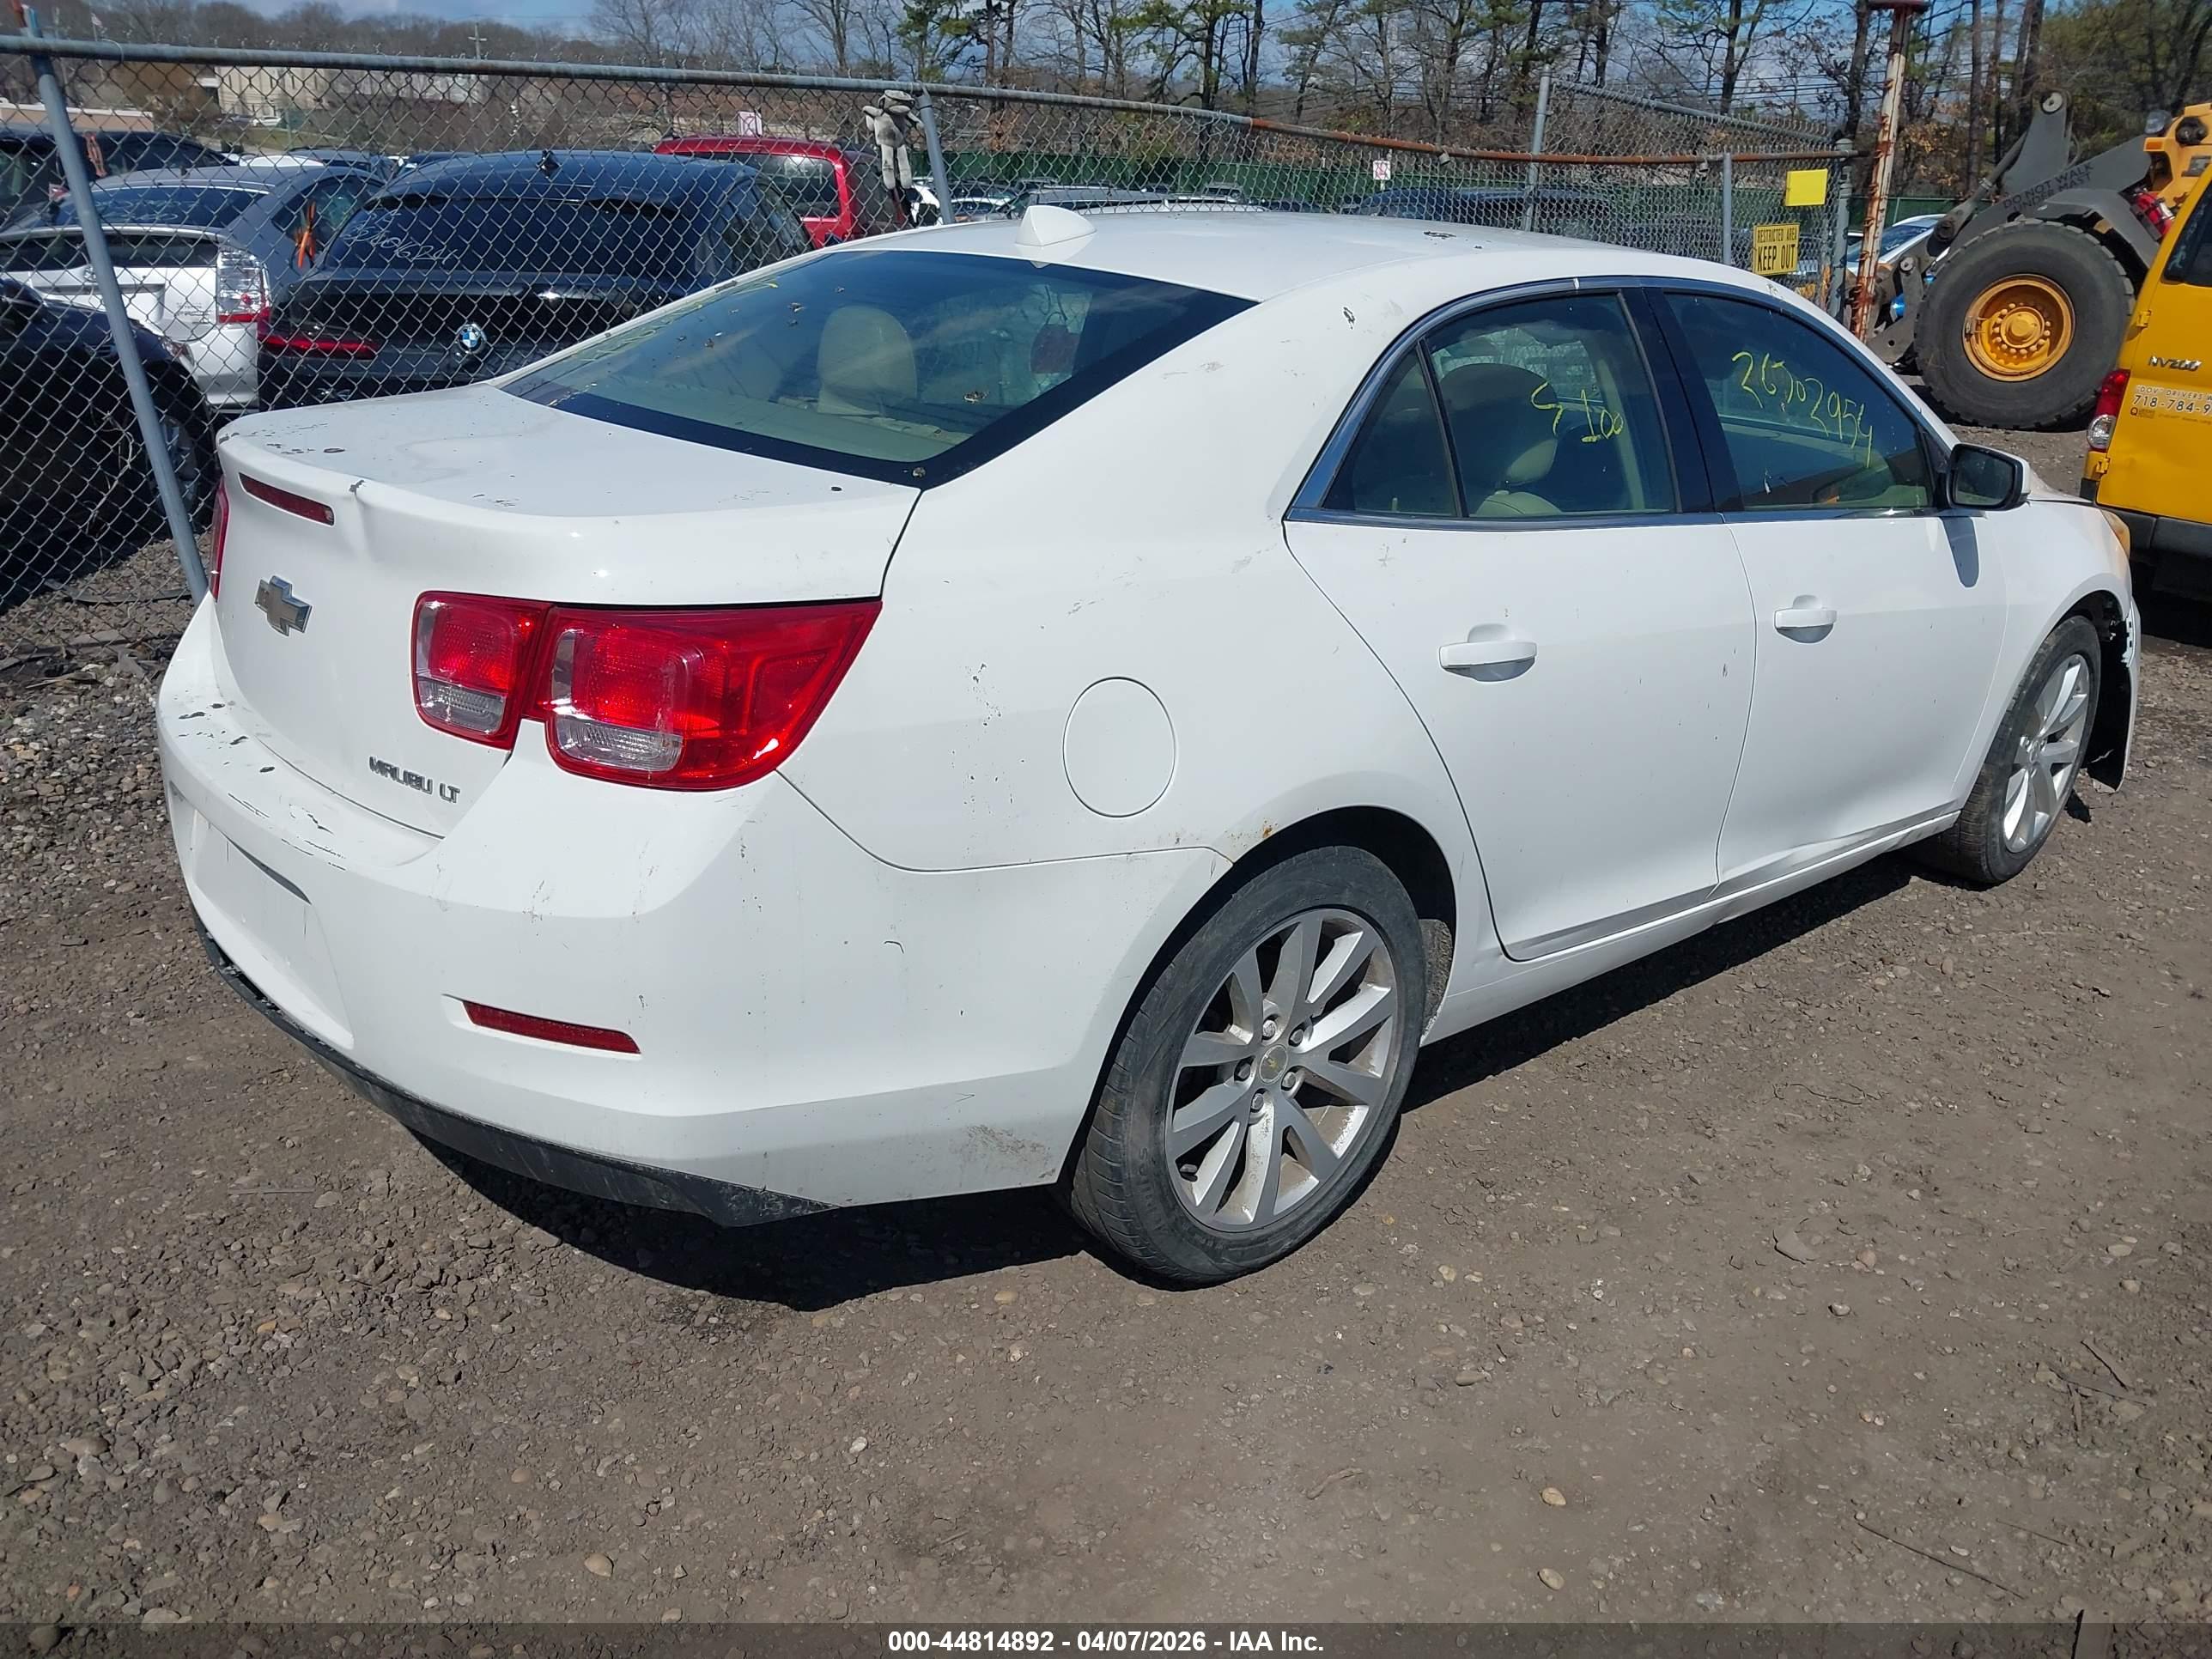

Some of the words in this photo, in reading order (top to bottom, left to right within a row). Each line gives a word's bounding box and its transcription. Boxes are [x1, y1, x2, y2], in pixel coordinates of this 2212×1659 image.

[2025, 179, 2053, 198] NOT
[2055, 162, 2094, 183] WALK
[2058, 172, 2091, 191] MAST
[1757, 245, 1778, 271] KEEP
[1780, 243, 1796, 270] OUT
[2166, 389, 2203, 400] DRIVERS
[368, 756, 434, 795] MALIBU
[439, 782, 461, 804] LT
